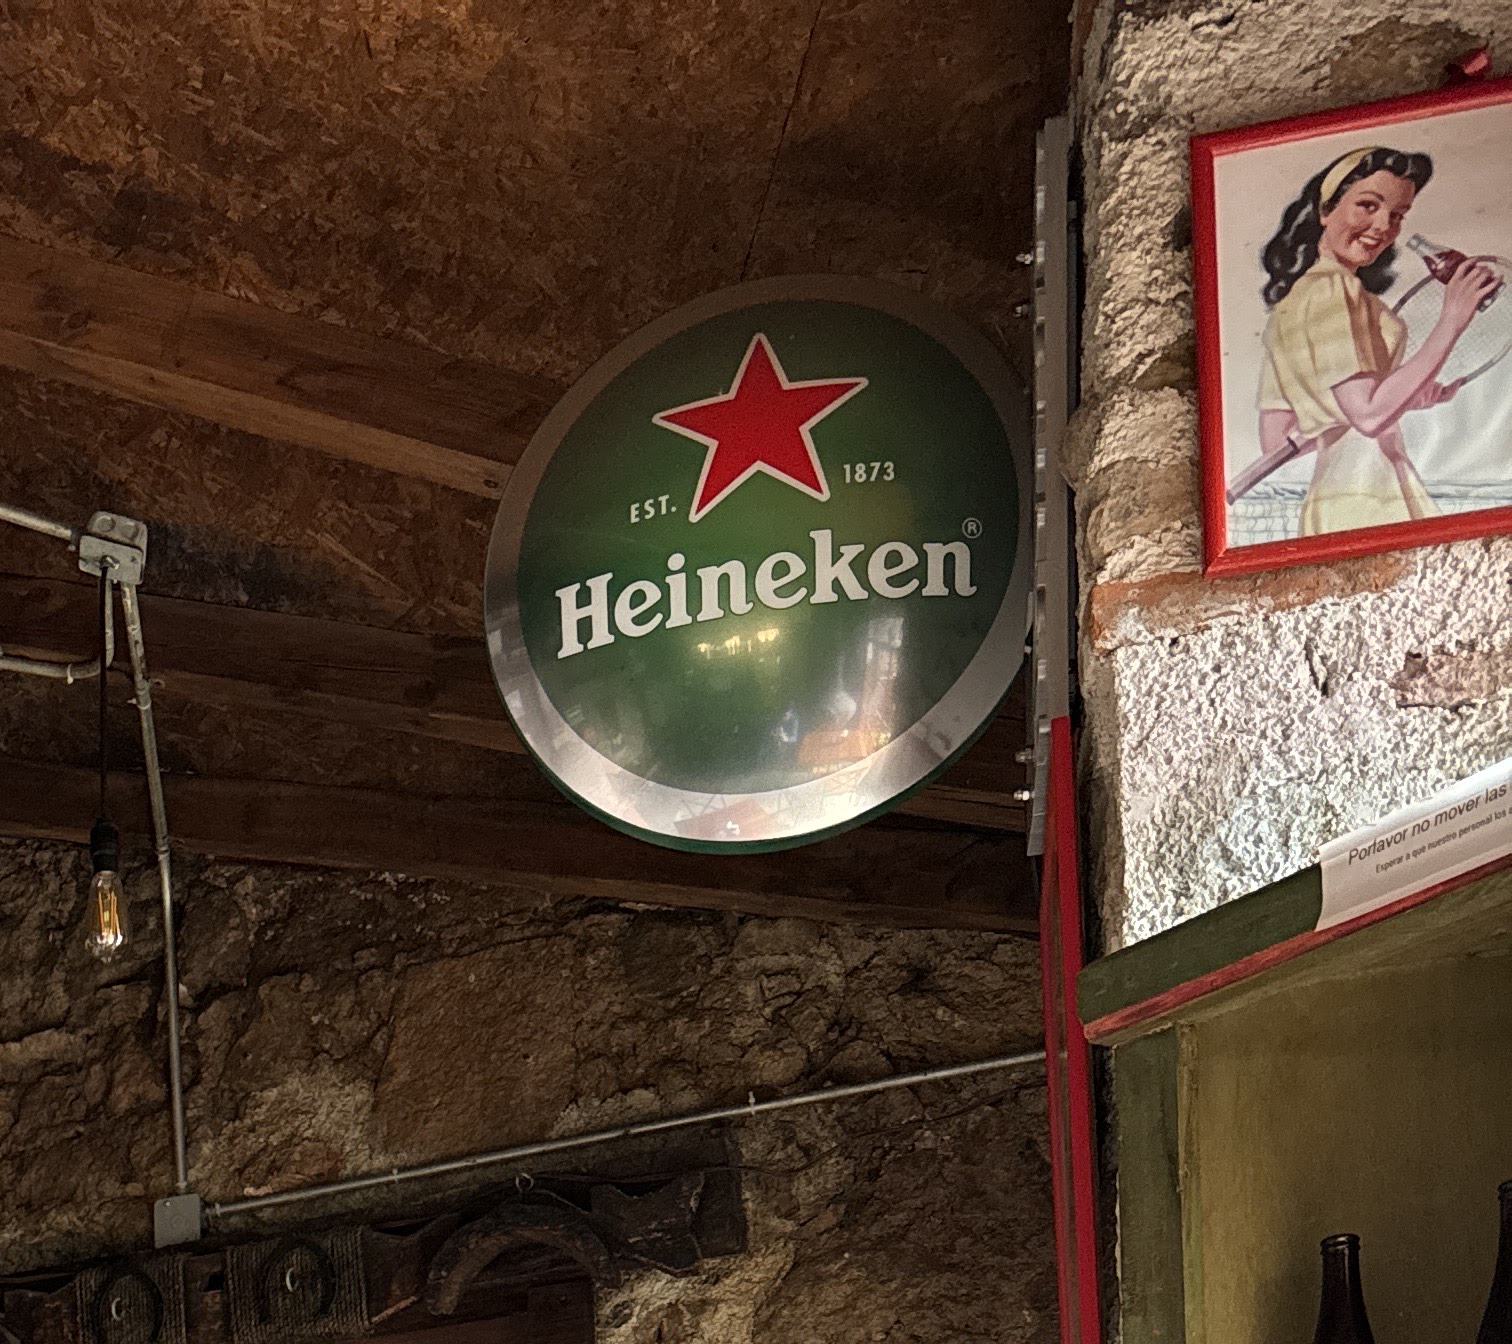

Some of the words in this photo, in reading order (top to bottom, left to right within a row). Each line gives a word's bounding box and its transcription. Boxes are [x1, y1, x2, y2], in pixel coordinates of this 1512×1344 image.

[629, 494, 677, 524] EST.
[842, 461, 896, 484] 1873
[555, 529, 977, 660] Heineken
[1375, 854, 1404, 873] Esperar
[1411, 845, 1426, 858] que
[1428, 831, 1457, 850] nuestro
[1458, 813, 1493, 838] personal
[1494, 809, 1507, 821] los
[1411, 818, 1430, 837] no
[1434, 794, 1481, 827] mover
[1485, 784, 1507, 805] las
